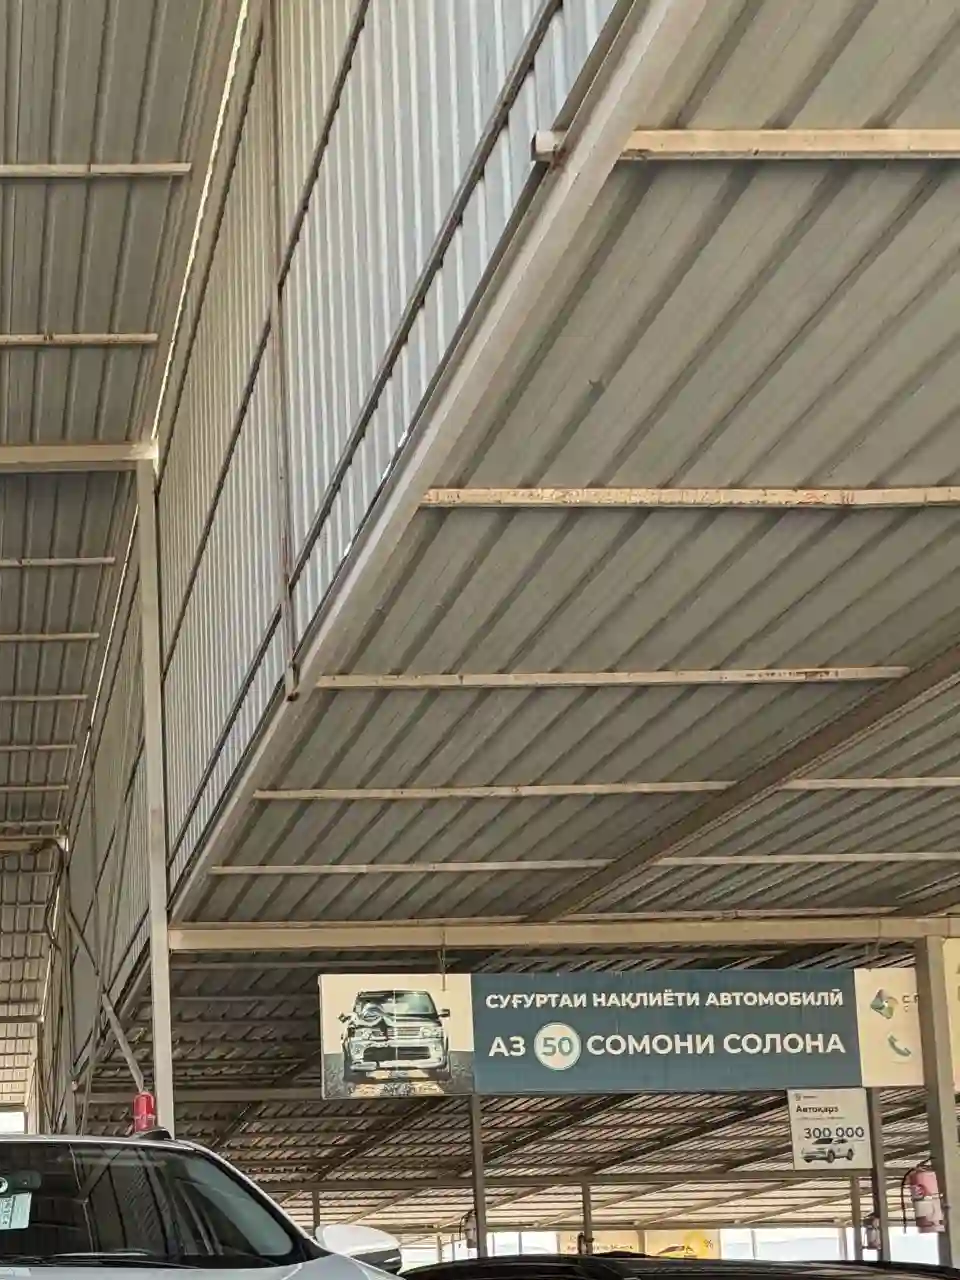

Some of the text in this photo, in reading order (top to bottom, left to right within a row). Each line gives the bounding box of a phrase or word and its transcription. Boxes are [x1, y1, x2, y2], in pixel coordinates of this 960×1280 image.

[485, 989, 843, 1009] СУҒУРТАИ НАҚЛИЁТИ АВТОМОБИЛӢ
[488, 1033, 846, 1057] АЗ 50 СОМОНИ СОЛОНА
[803, 1126, 864, 1139] 300 000
